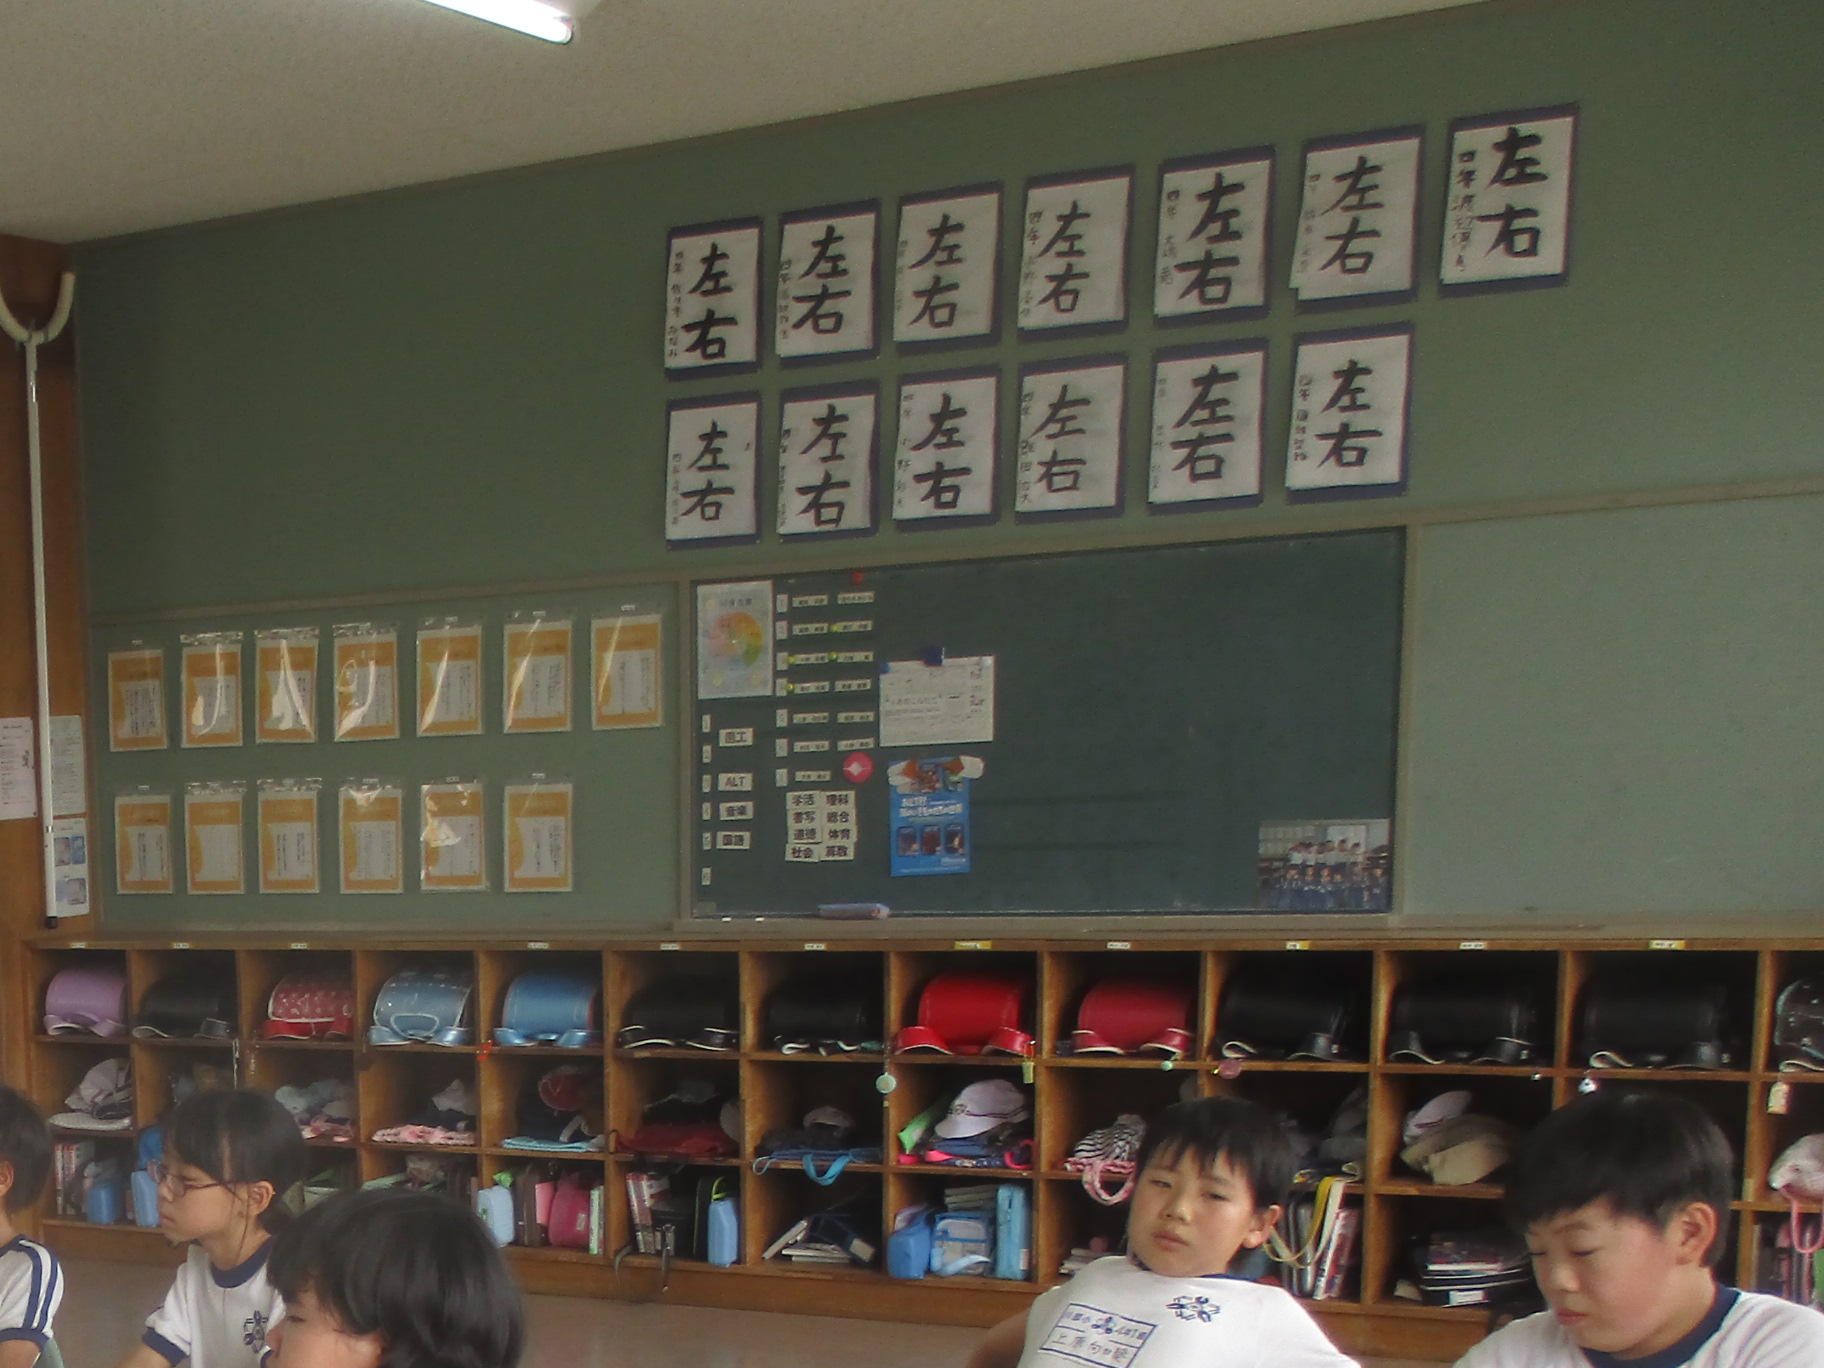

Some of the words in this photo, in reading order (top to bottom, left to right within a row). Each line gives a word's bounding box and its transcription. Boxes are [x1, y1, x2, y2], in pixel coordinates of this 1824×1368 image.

[1174, 172, 1245, 305] 左右
[1317, 155, 1384, 274] 左右
[1473, 126, 1549, 258] 左右
[681, 242, 738, 360] 左右
[791, 223, 852, 334] 左右
[906, 213, 966, 329] 左右
[1035, 200, 1092, 313] 左右
[680, 419, 735, 521] 左右
[795, 403, 851, 527] 左右
[909, 392, 972, 509] 左右
[1029, 384, 1092, 492] 左右
[1169, 364, 1239, 483] 左右
[1315, 358, 1383, 469] 左右
[726, 776, 746, 787] ALT
[828, 828, 851, 840] 体育
[791, 847, 814, 859] 社会
